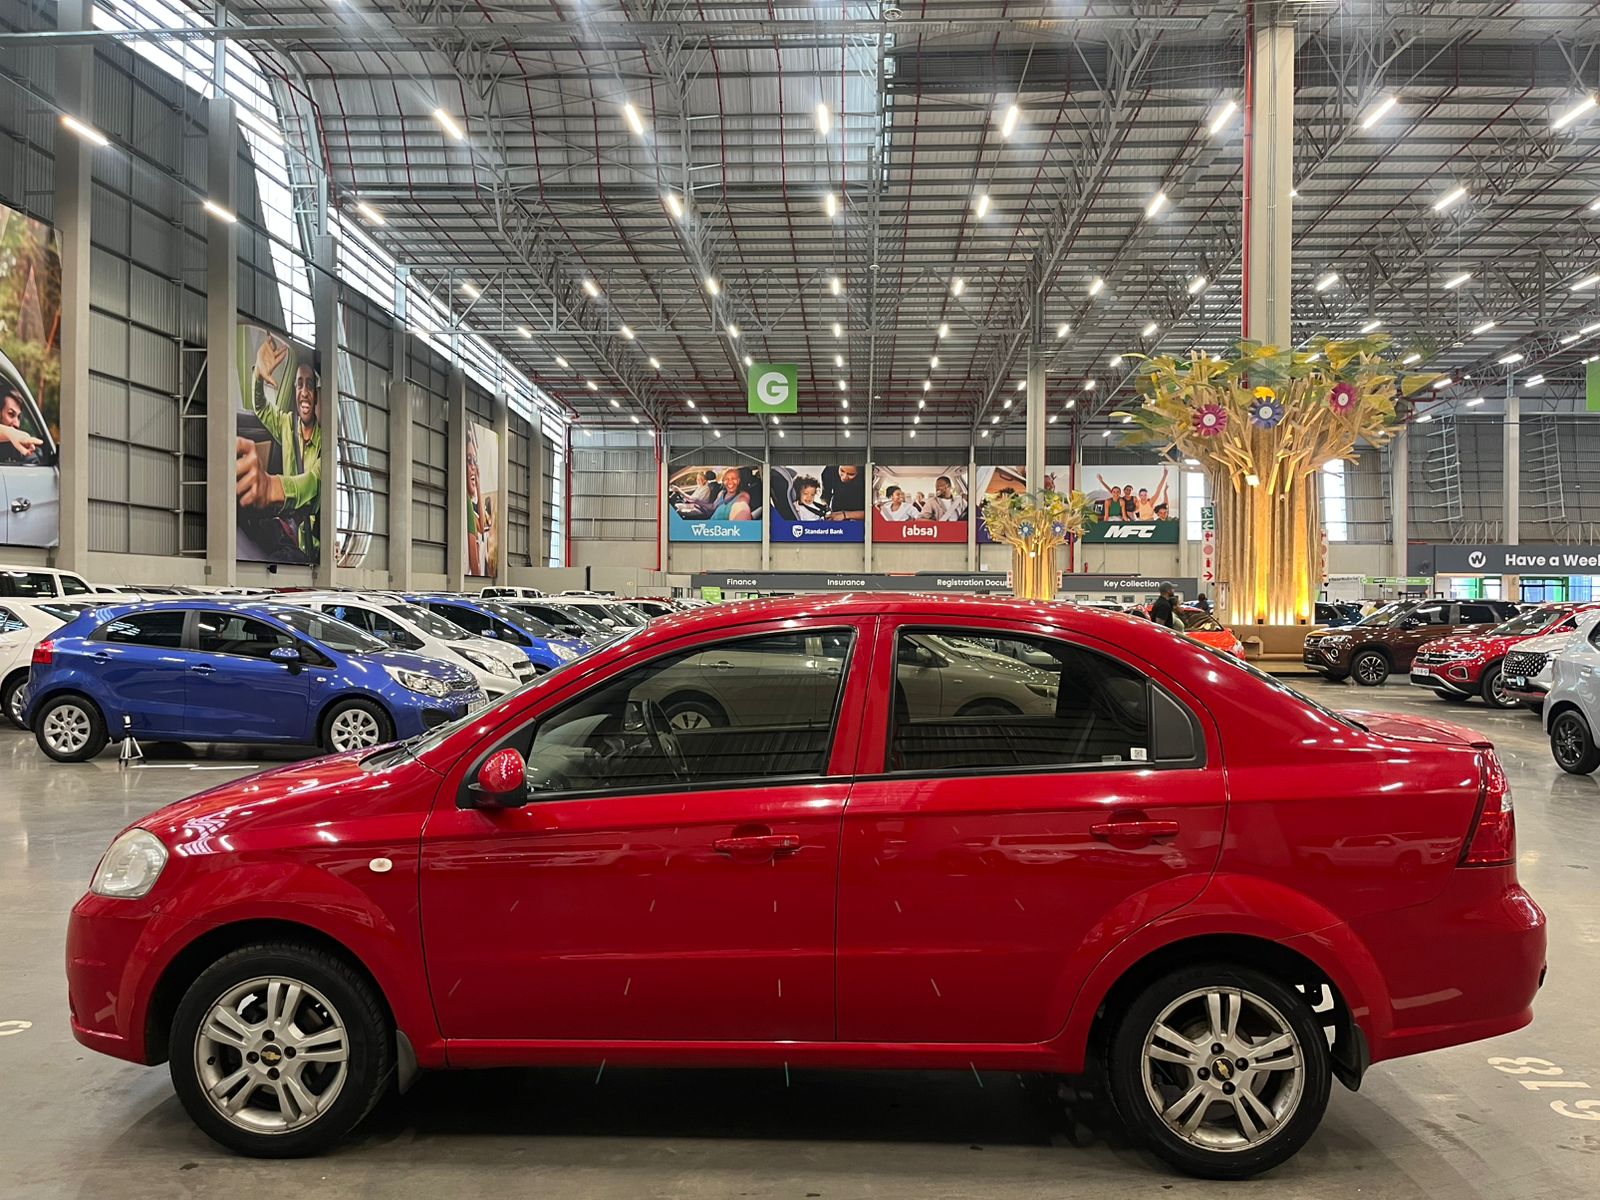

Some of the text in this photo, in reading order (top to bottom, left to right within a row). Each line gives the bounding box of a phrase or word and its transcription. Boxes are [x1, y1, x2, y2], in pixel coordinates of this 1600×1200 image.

[756, 371, 789, 405] G
[691, 523, 740, 536] WesBank
[902, 522, 938, 538] (absa)
[1104, 525, 1157, 538] MFC
[1505, 554, 1546, 566] Have
[1549, 556, 1559, 566] a
[1563, 554, 1600, 566] Wee
[726, 578, 757, 586] Finance
[827, 578, 866, 586] Insurance
[937, 579, 984, 588] Registration
[1103, 580, 1119, 589] Key
